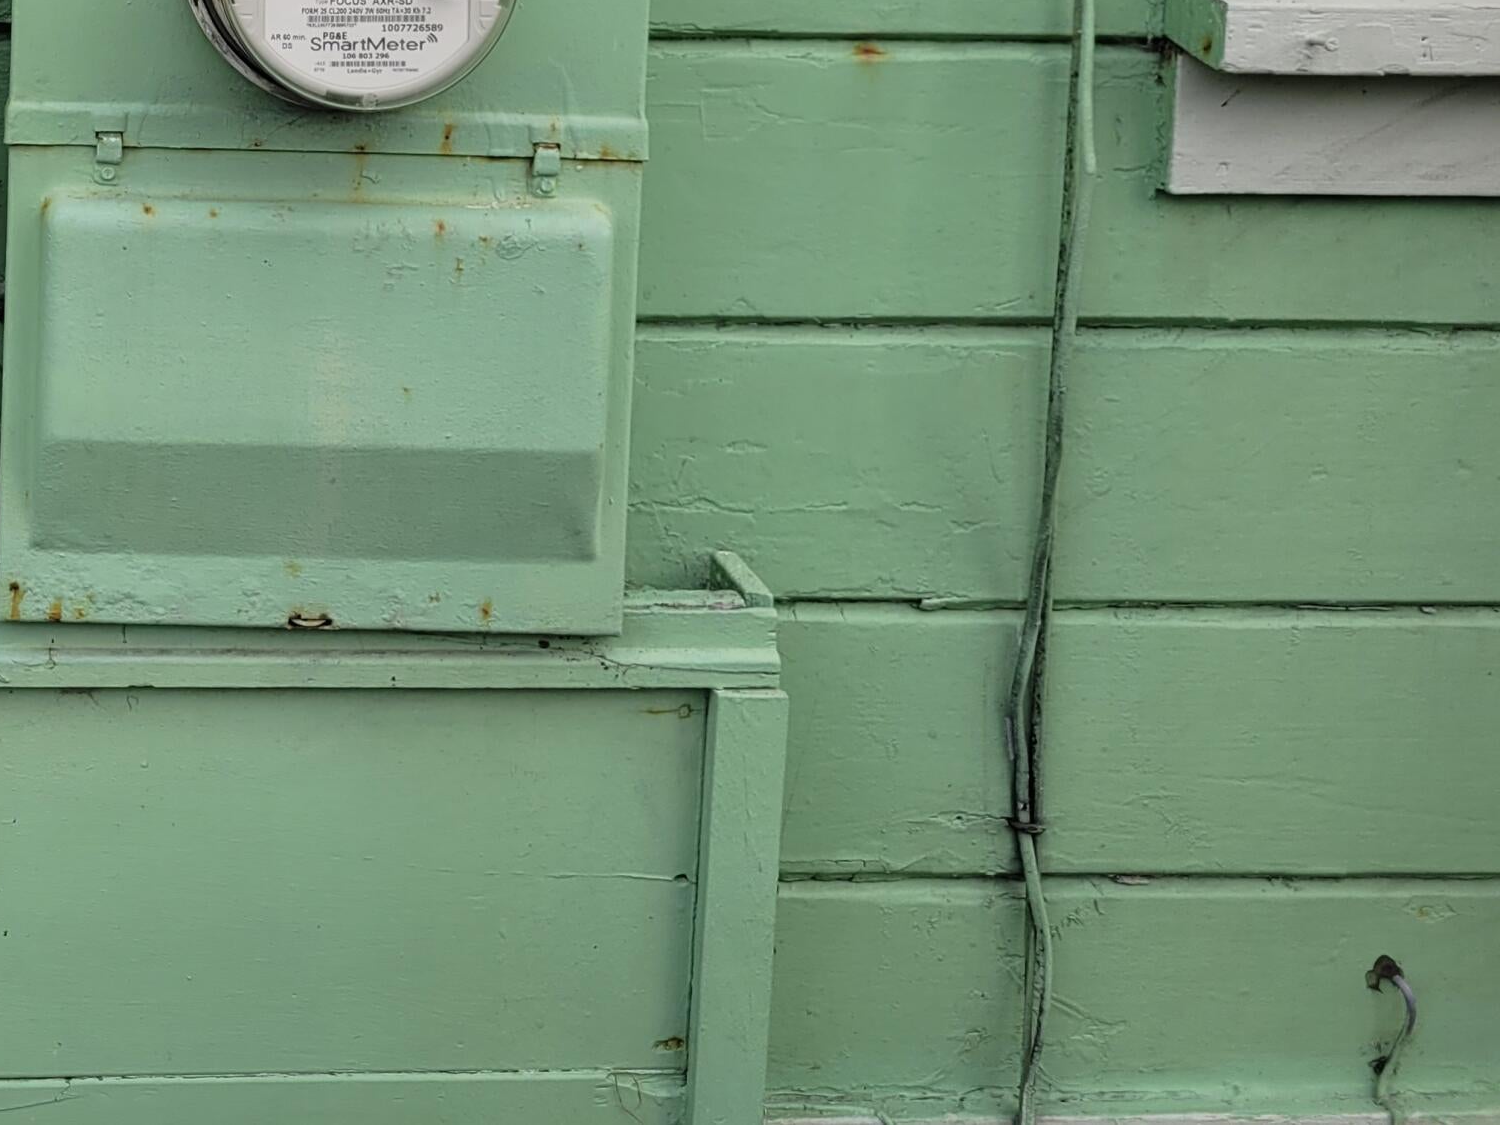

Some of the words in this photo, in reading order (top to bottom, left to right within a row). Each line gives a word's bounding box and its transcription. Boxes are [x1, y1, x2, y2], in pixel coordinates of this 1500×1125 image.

[301, 7, 318, 15] FORM
[329, 7, 347, 15] CL200
[382, 24, 444, 32] 1007726589
[323, 31, 348, 40] PG&E
[310, 36, 426, 51] SmartMeter
[342, 52, 357, 60] 106
[358, 52, 373, 60] 803
[375, 52, 390, 60] 296
